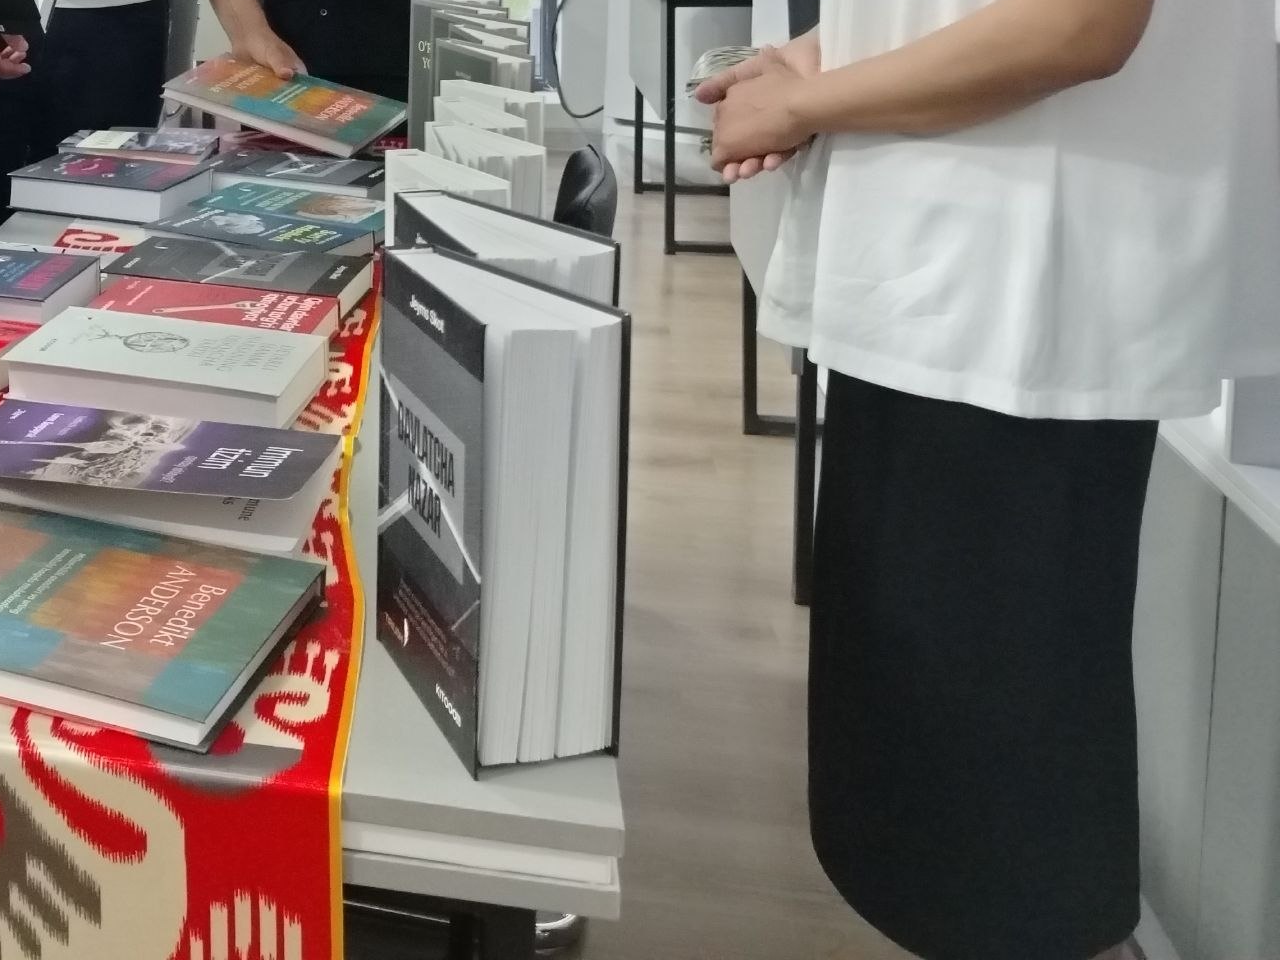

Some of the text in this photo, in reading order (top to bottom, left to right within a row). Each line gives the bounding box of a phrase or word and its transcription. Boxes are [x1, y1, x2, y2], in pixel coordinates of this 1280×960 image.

[409, 295, 445, 333] Jeyms Skot
[196, 446, 253, 470] tizim
[237, 445, 304, 478] Immun
[397, 399, 456, 498] DAVLATCHA
[407, 465, 442, 539] NAZAR
[94, 563, 199, 652] ANDERSON
[146, 582, 229, 649] Benedikt
